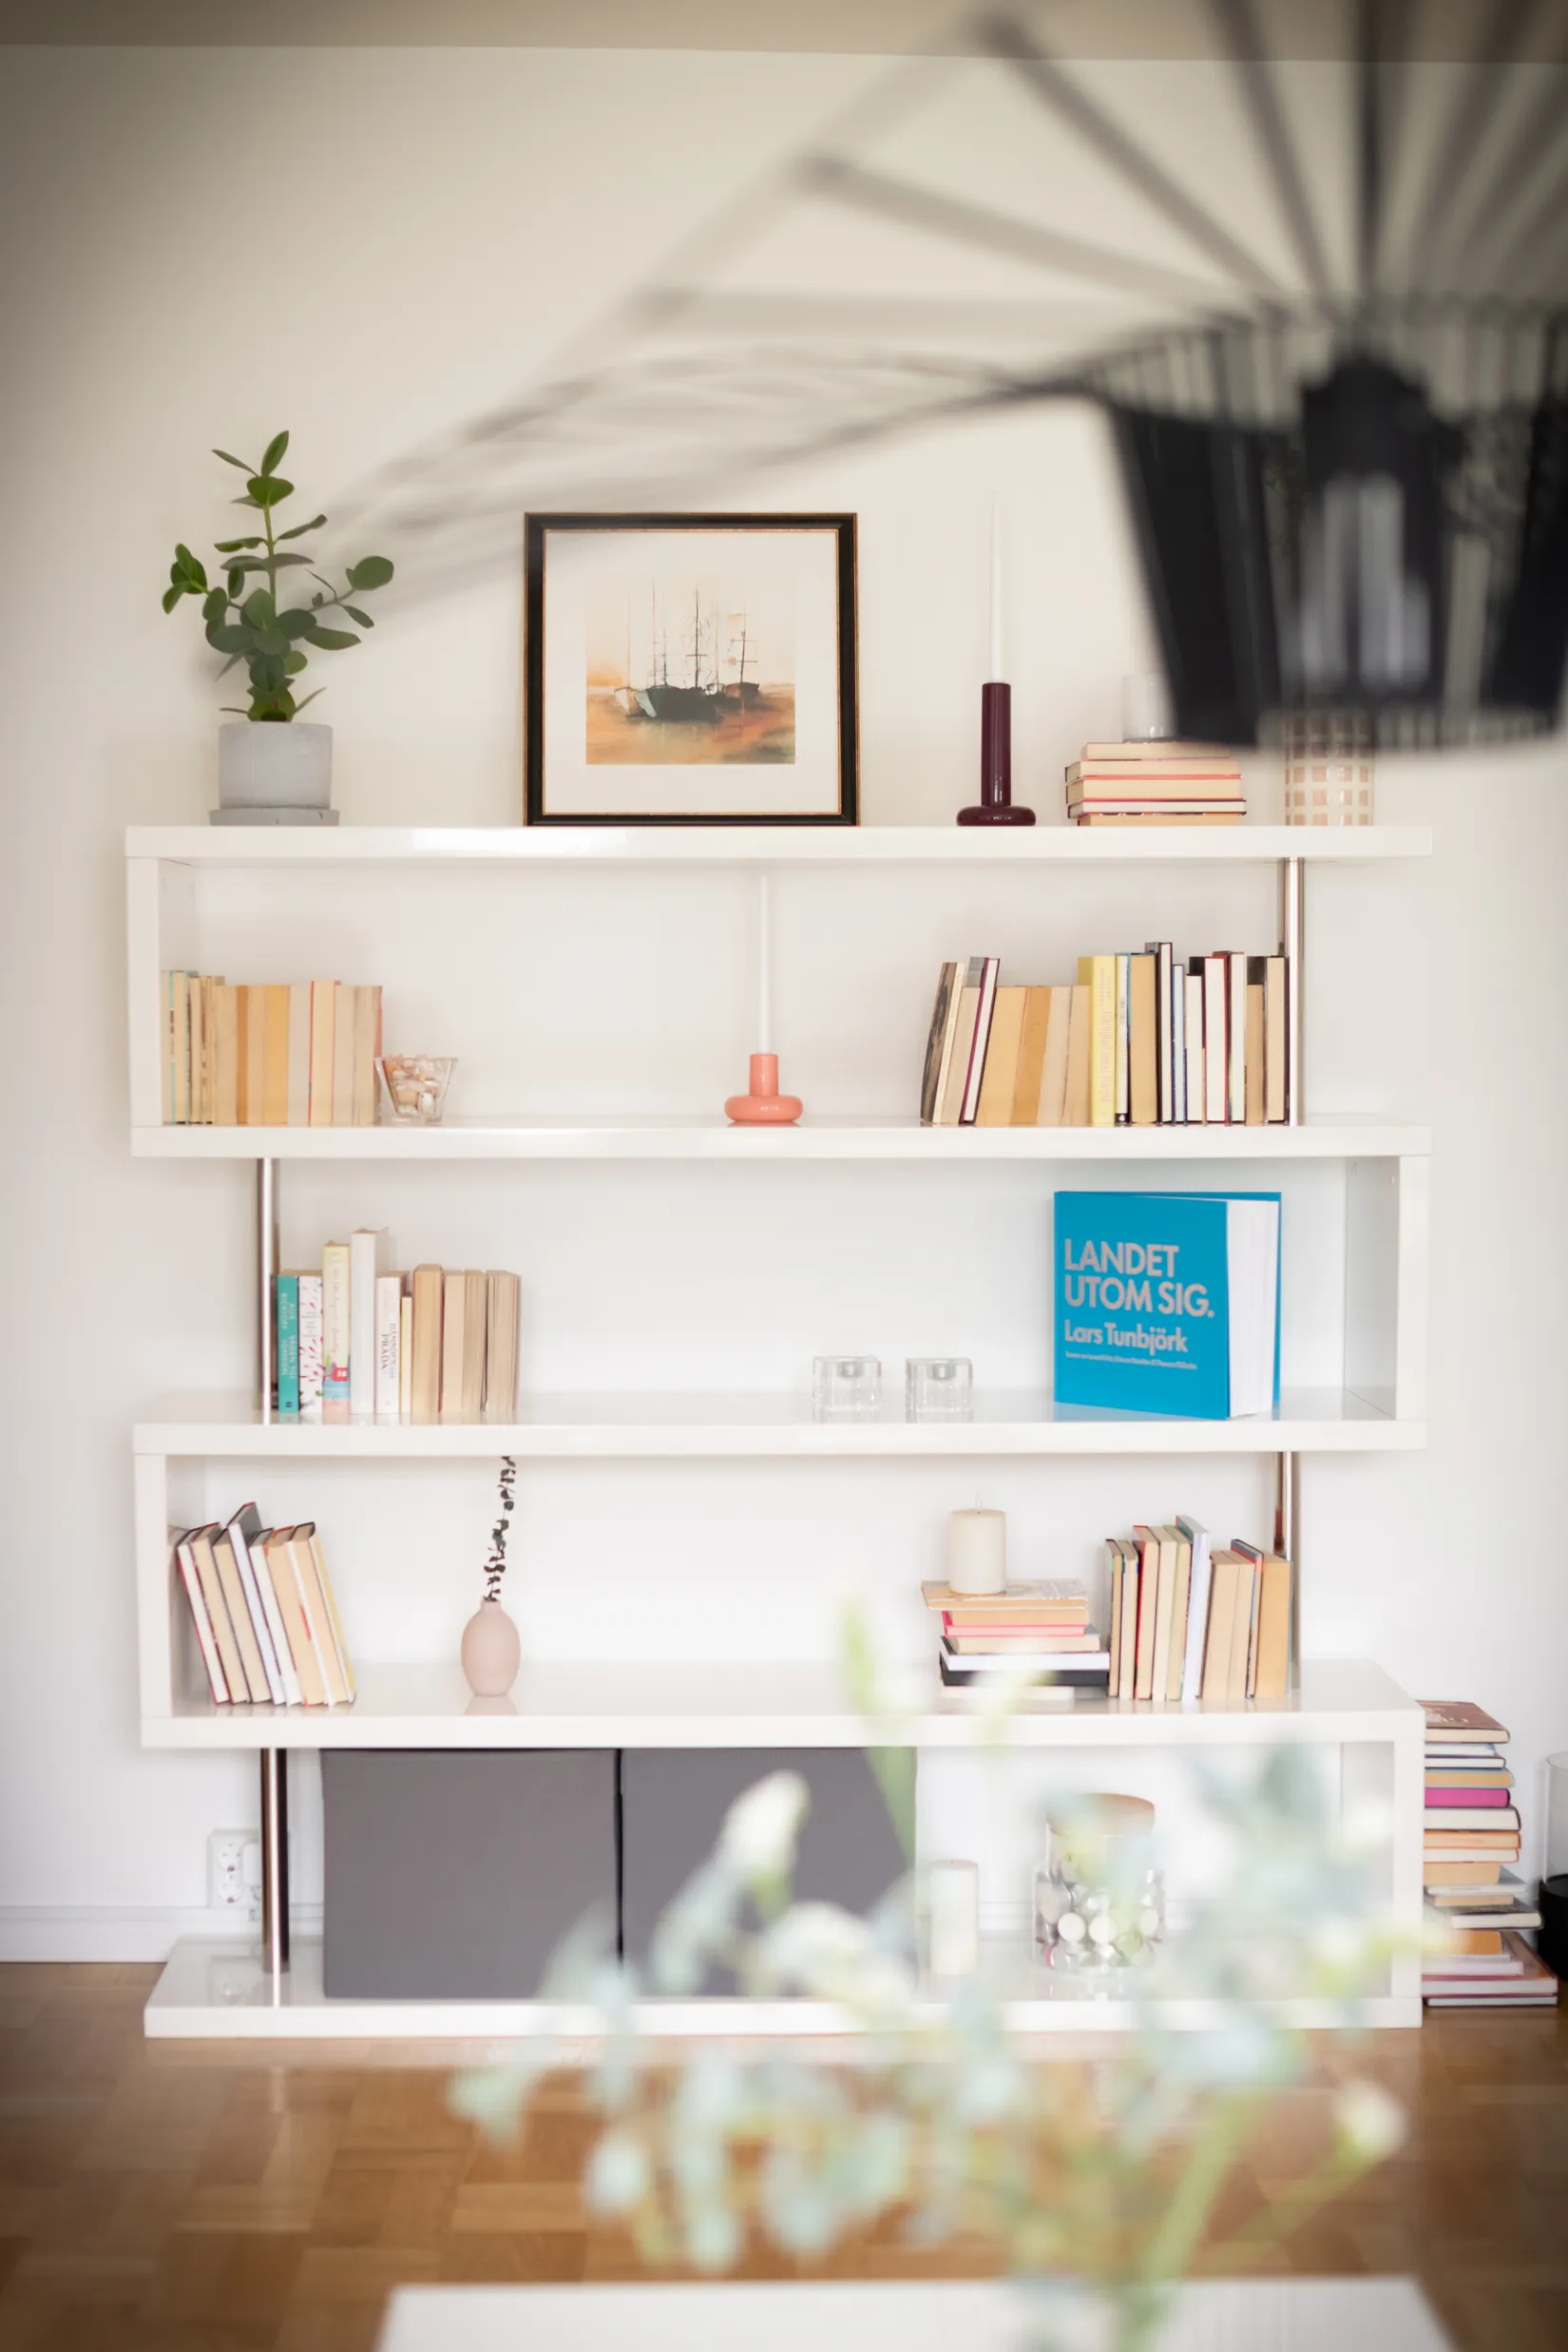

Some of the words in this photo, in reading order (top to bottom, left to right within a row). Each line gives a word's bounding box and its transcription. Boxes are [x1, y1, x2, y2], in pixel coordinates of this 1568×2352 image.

[1064, 1238, 1179, 1277] LANDET
[1064, 1274, 1153, 1312] UTOM
[1157, 1281, 1215, 1318] SIG.
[1064, 1319, 1103, 1345] Lars
[1104, 1322, 1189, 1356] Tunbjörk
